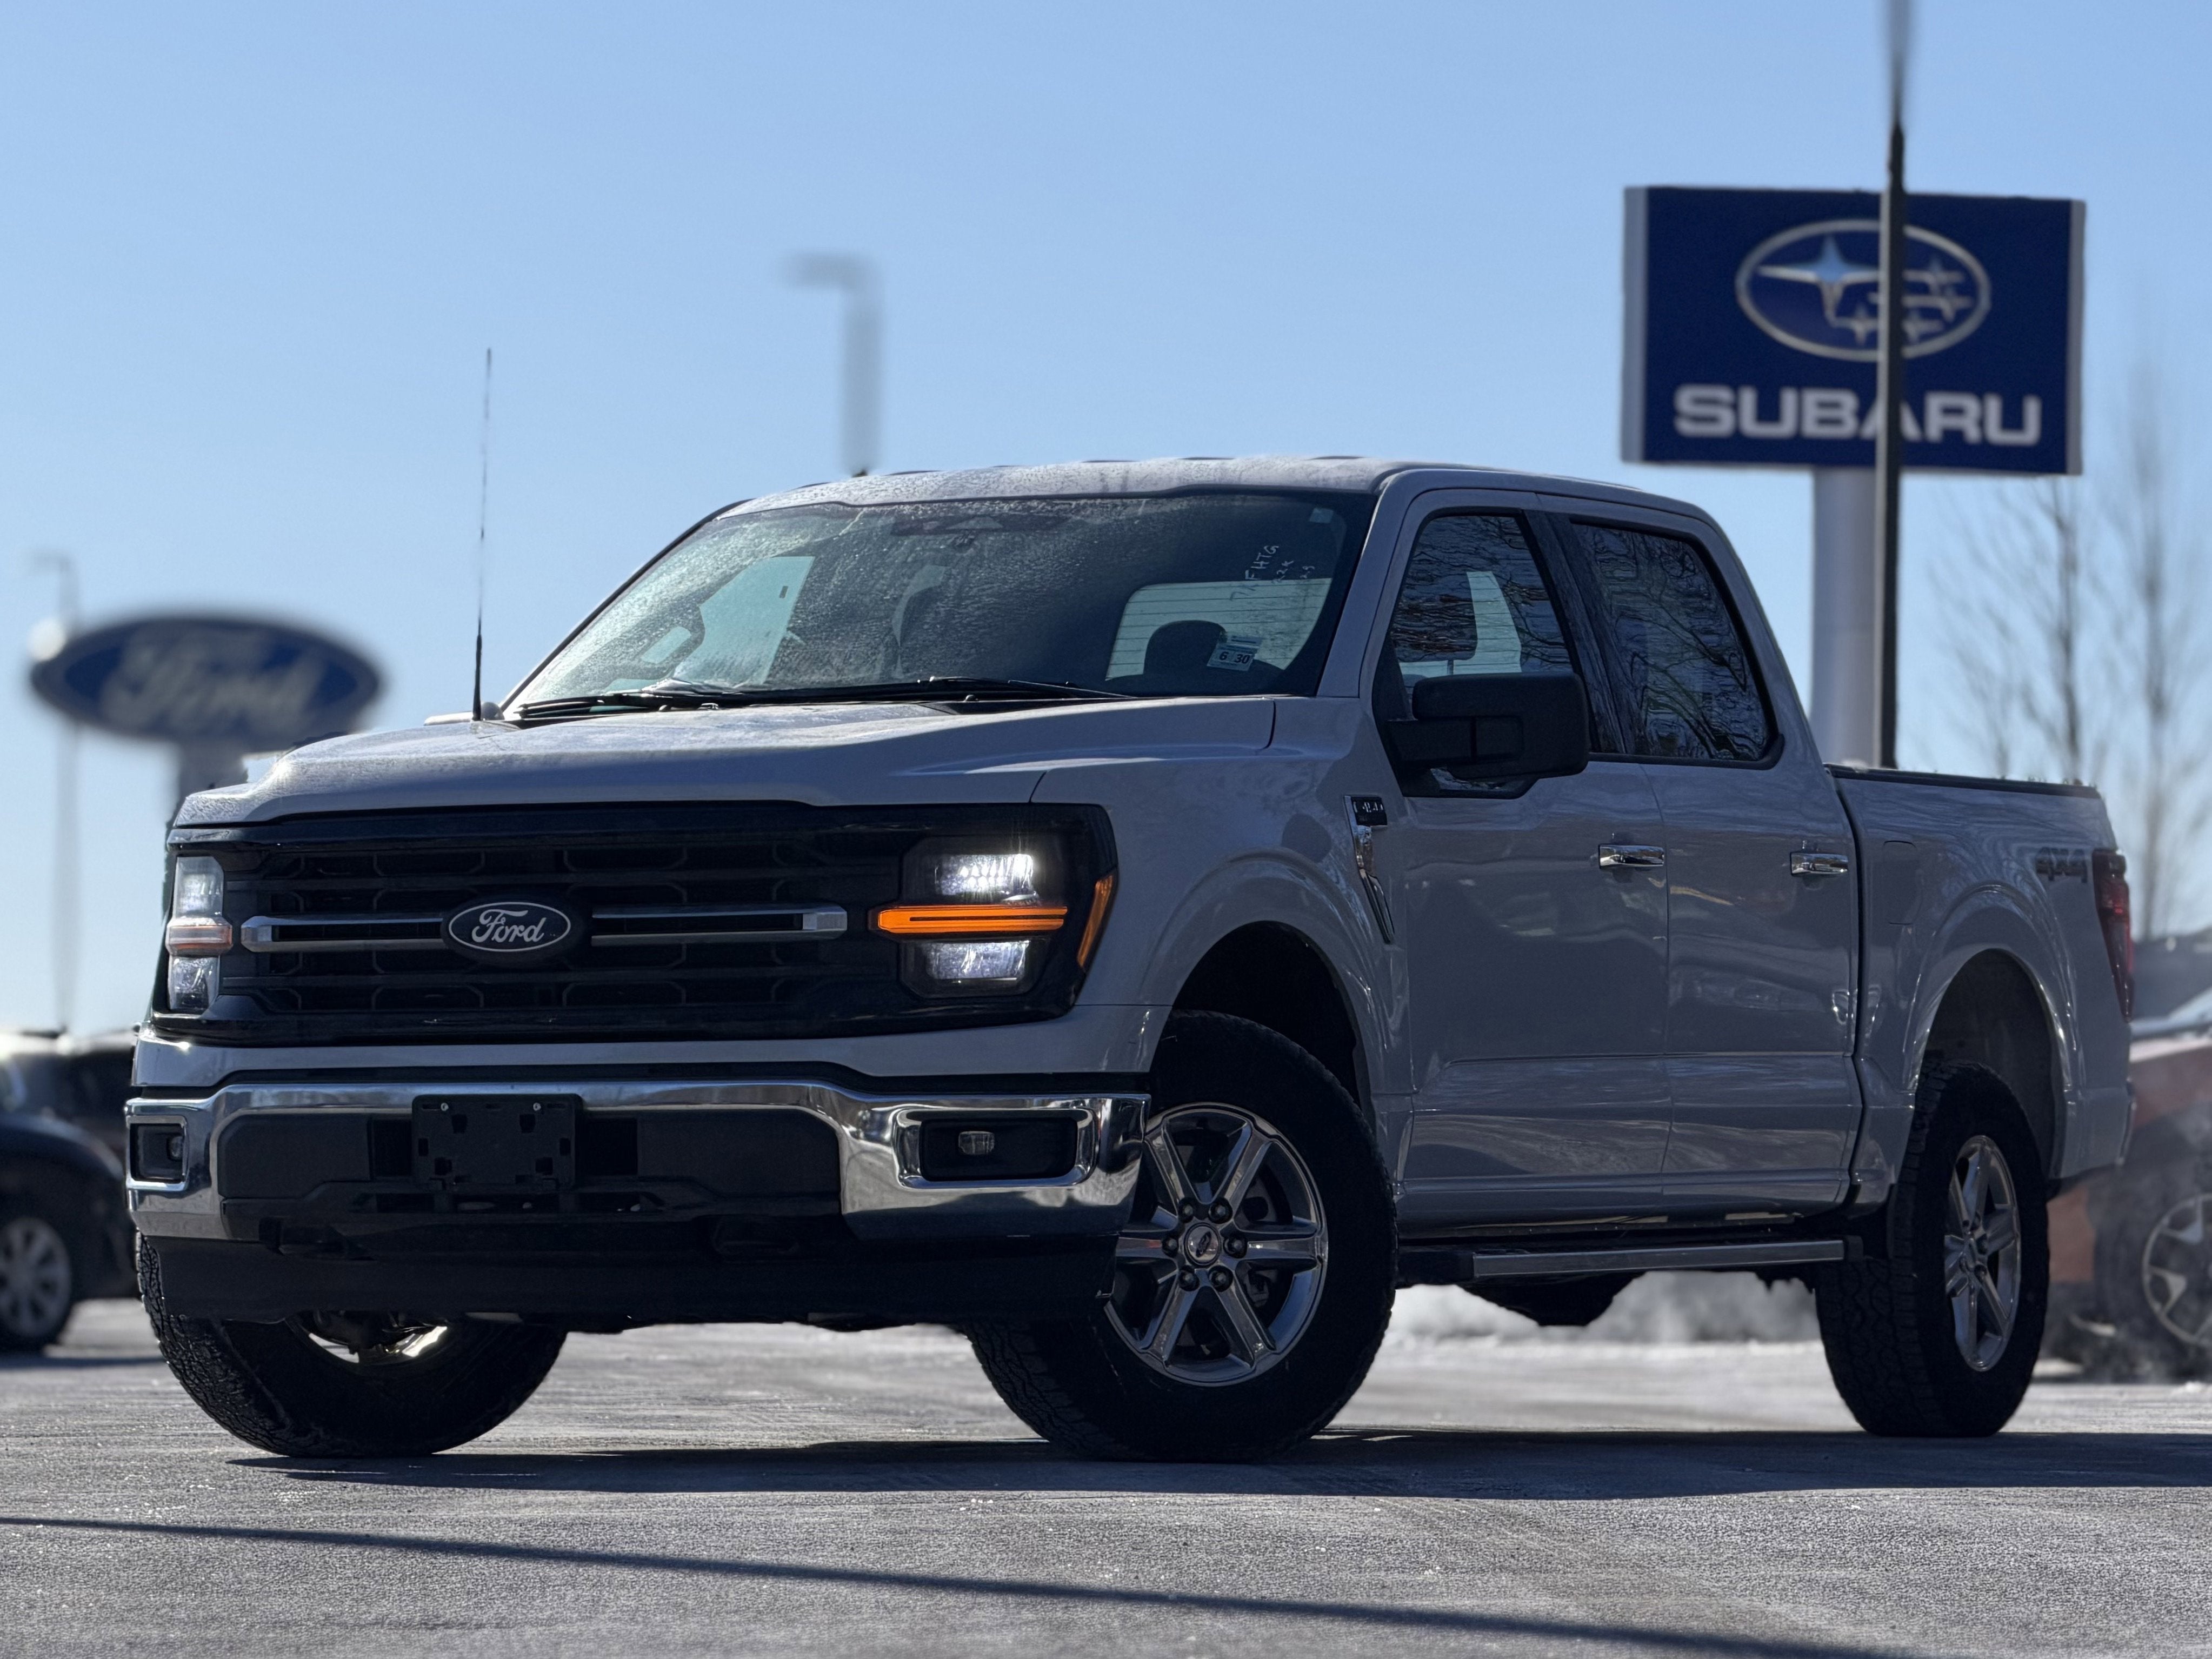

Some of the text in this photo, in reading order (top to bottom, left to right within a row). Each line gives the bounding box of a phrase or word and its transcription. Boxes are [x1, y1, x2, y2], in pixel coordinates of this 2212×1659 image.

[1219, 651, 1229, 661] 6
[1234, 654, 1250, 664] 30
[471, 909, 547, 943] Ford
